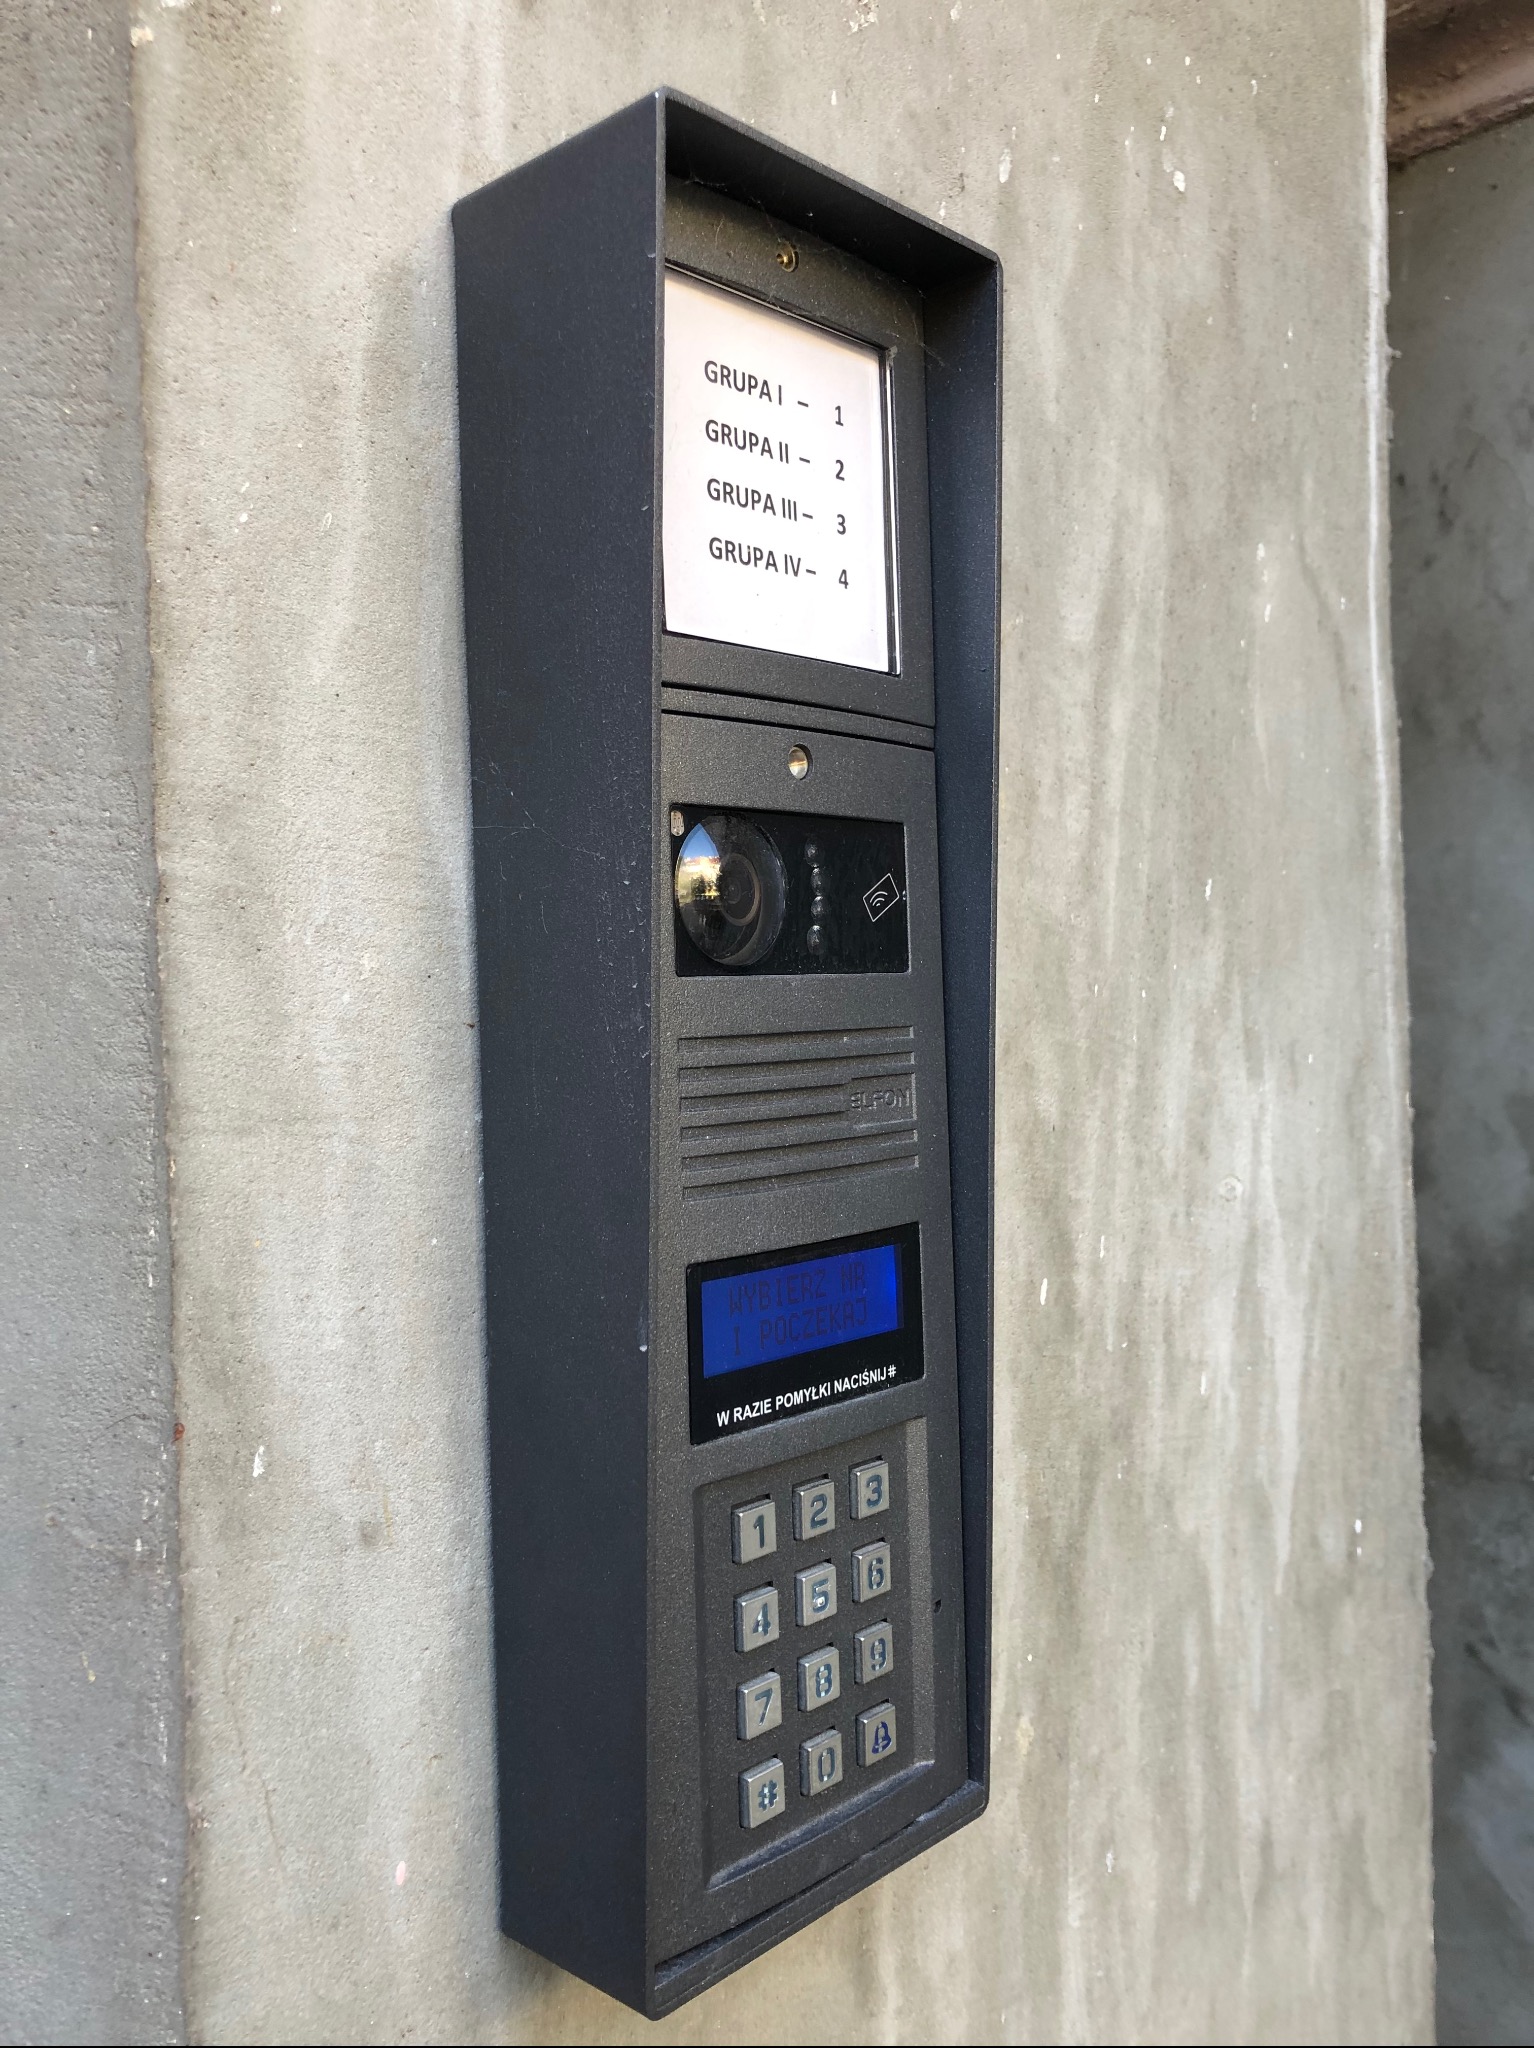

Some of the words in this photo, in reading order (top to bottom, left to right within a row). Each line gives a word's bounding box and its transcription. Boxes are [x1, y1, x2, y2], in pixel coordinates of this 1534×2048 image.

[704, 360, 772, 403] GRUPA
[777, 384, 783, 406] I
[834, 405, 844, 427] 1
[705, 419, 774, 460] GRUPA
[778, 441, 789, 464] II
[835, 459, 845, 481] 2
[707, 478, 776, 516] GRUPA
[781, 497, 797, 522] III
[836, 513, 847, 536] 3
[709, 537, 778, 573] GRUPA
[784, 553, 801, 577] IV
[838, 569, 849, 590] 4
[728, 1267, 827, 1318] WYBIERZ
[733, 1326, 741, 1357] I
[759, 1297, 868, 1350] POCZEKAJ
[716, 1410, 730, 1427] W
[733, 1398, 772, 1423] RAZIE
[775, 1382, 831, 1410] POMYŁKI
[753, 1514, 765, 1549] 1
[810, 1493, 828, 1529] 2
[866, 1474, 883, 1508] 3
[752, 1603, 771, 1637] 4
[812, 1578, 829, 1613] 5
[868, 1557, 885, 1590] 6
[755, 1688, 773, 1726] 7
[815, 1663, 833, 1698] 8
[870, 1637, 887, 1672] 9
[818, 1747, 836, 1783] 0
